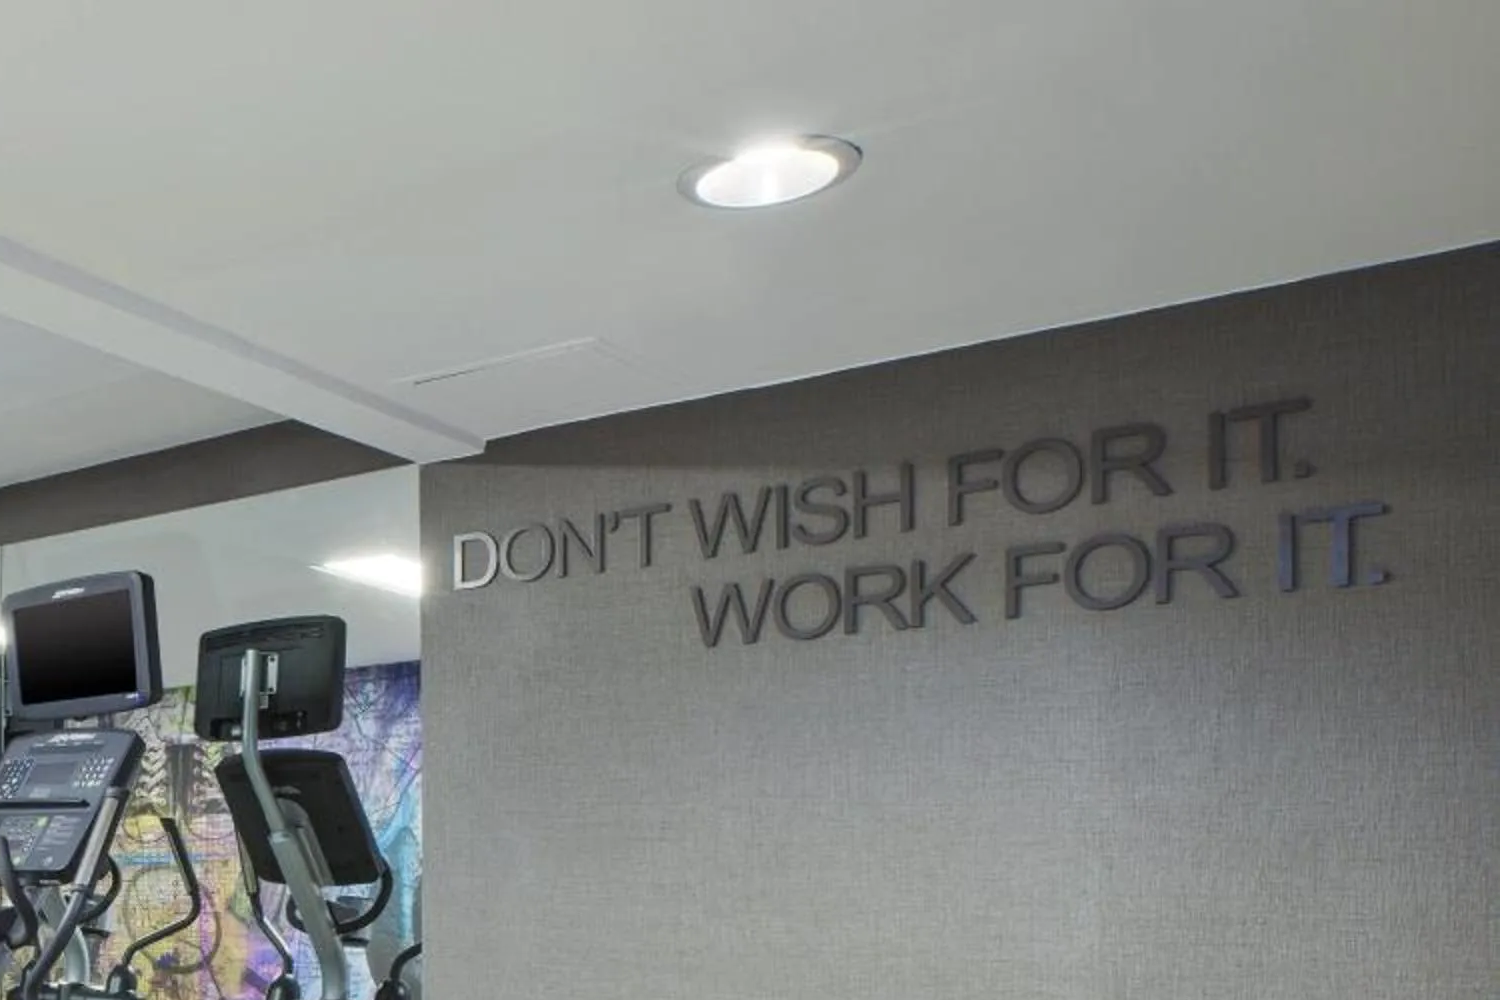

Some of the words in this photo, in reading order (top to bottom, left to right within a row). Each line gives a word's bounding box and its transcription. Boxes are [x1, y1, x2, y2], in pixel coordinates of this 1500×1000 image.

[452, 502, 672, 592] DON'T
[689, 459, 916, 560] WISH
[947, 421, 1173, 526] FOR
[1207, 398, 1317, 490] IT.
[691, 552, 978, 647] WORK
[1003, 521, 1241, 619] FOR
[1277, 502, 1393, 592] IT.
